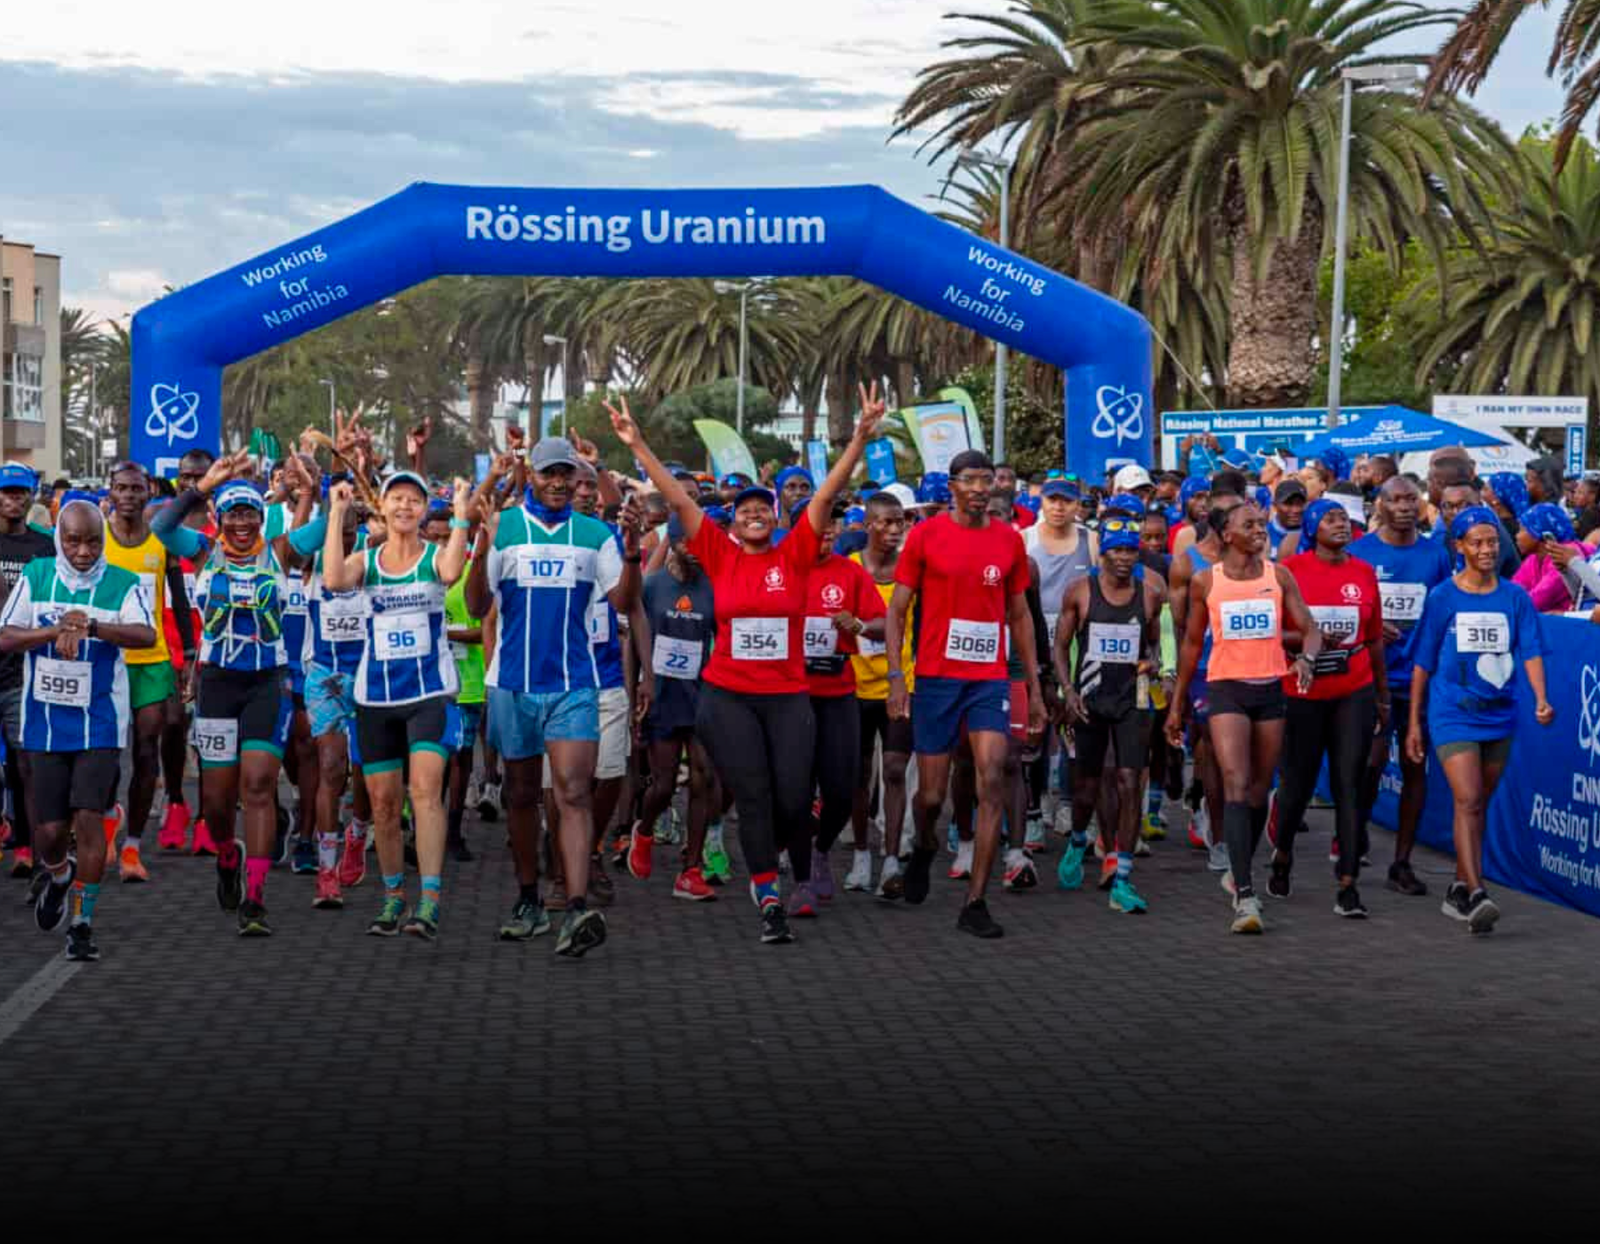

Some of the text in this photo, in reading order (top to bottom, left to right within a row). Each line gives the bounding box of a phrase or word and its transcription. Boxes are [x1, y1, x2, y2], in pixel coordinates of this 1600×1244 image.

[466, 204, 825, 252] Rössing Uranium
[241, 244, 328, 288] Working
[968, 246, 1046, 296] Working
[280, 276, 309, 299] for
[980, 278, 1011, 303] for
[262, 283, 350, 329] Namibia
[943, 285, 1030, 332] Namibia
[1213, 415, 1261, 428] National
[1263, 415, 1317, 428] Marathon
[529, 560, 565, 576] 107
[1383, 597, 1415, 610] 437
[327, 617, 360, 632] 542
[1230, 613, 1269, 630] 809
[387, 630, 416, 648] 96
[740, 633, 778, 649] 354
[949, 634, 996, 653] 3068
[1467, 628, 1498, 643] 316
[1099, 638, 1131, 654] 130
[665, 652, 689, 669] 22
[41, 674, 79, 694] 599
[1529, 792, 1590, 853] Rössing
[1580, 858, 1594, 887] for
